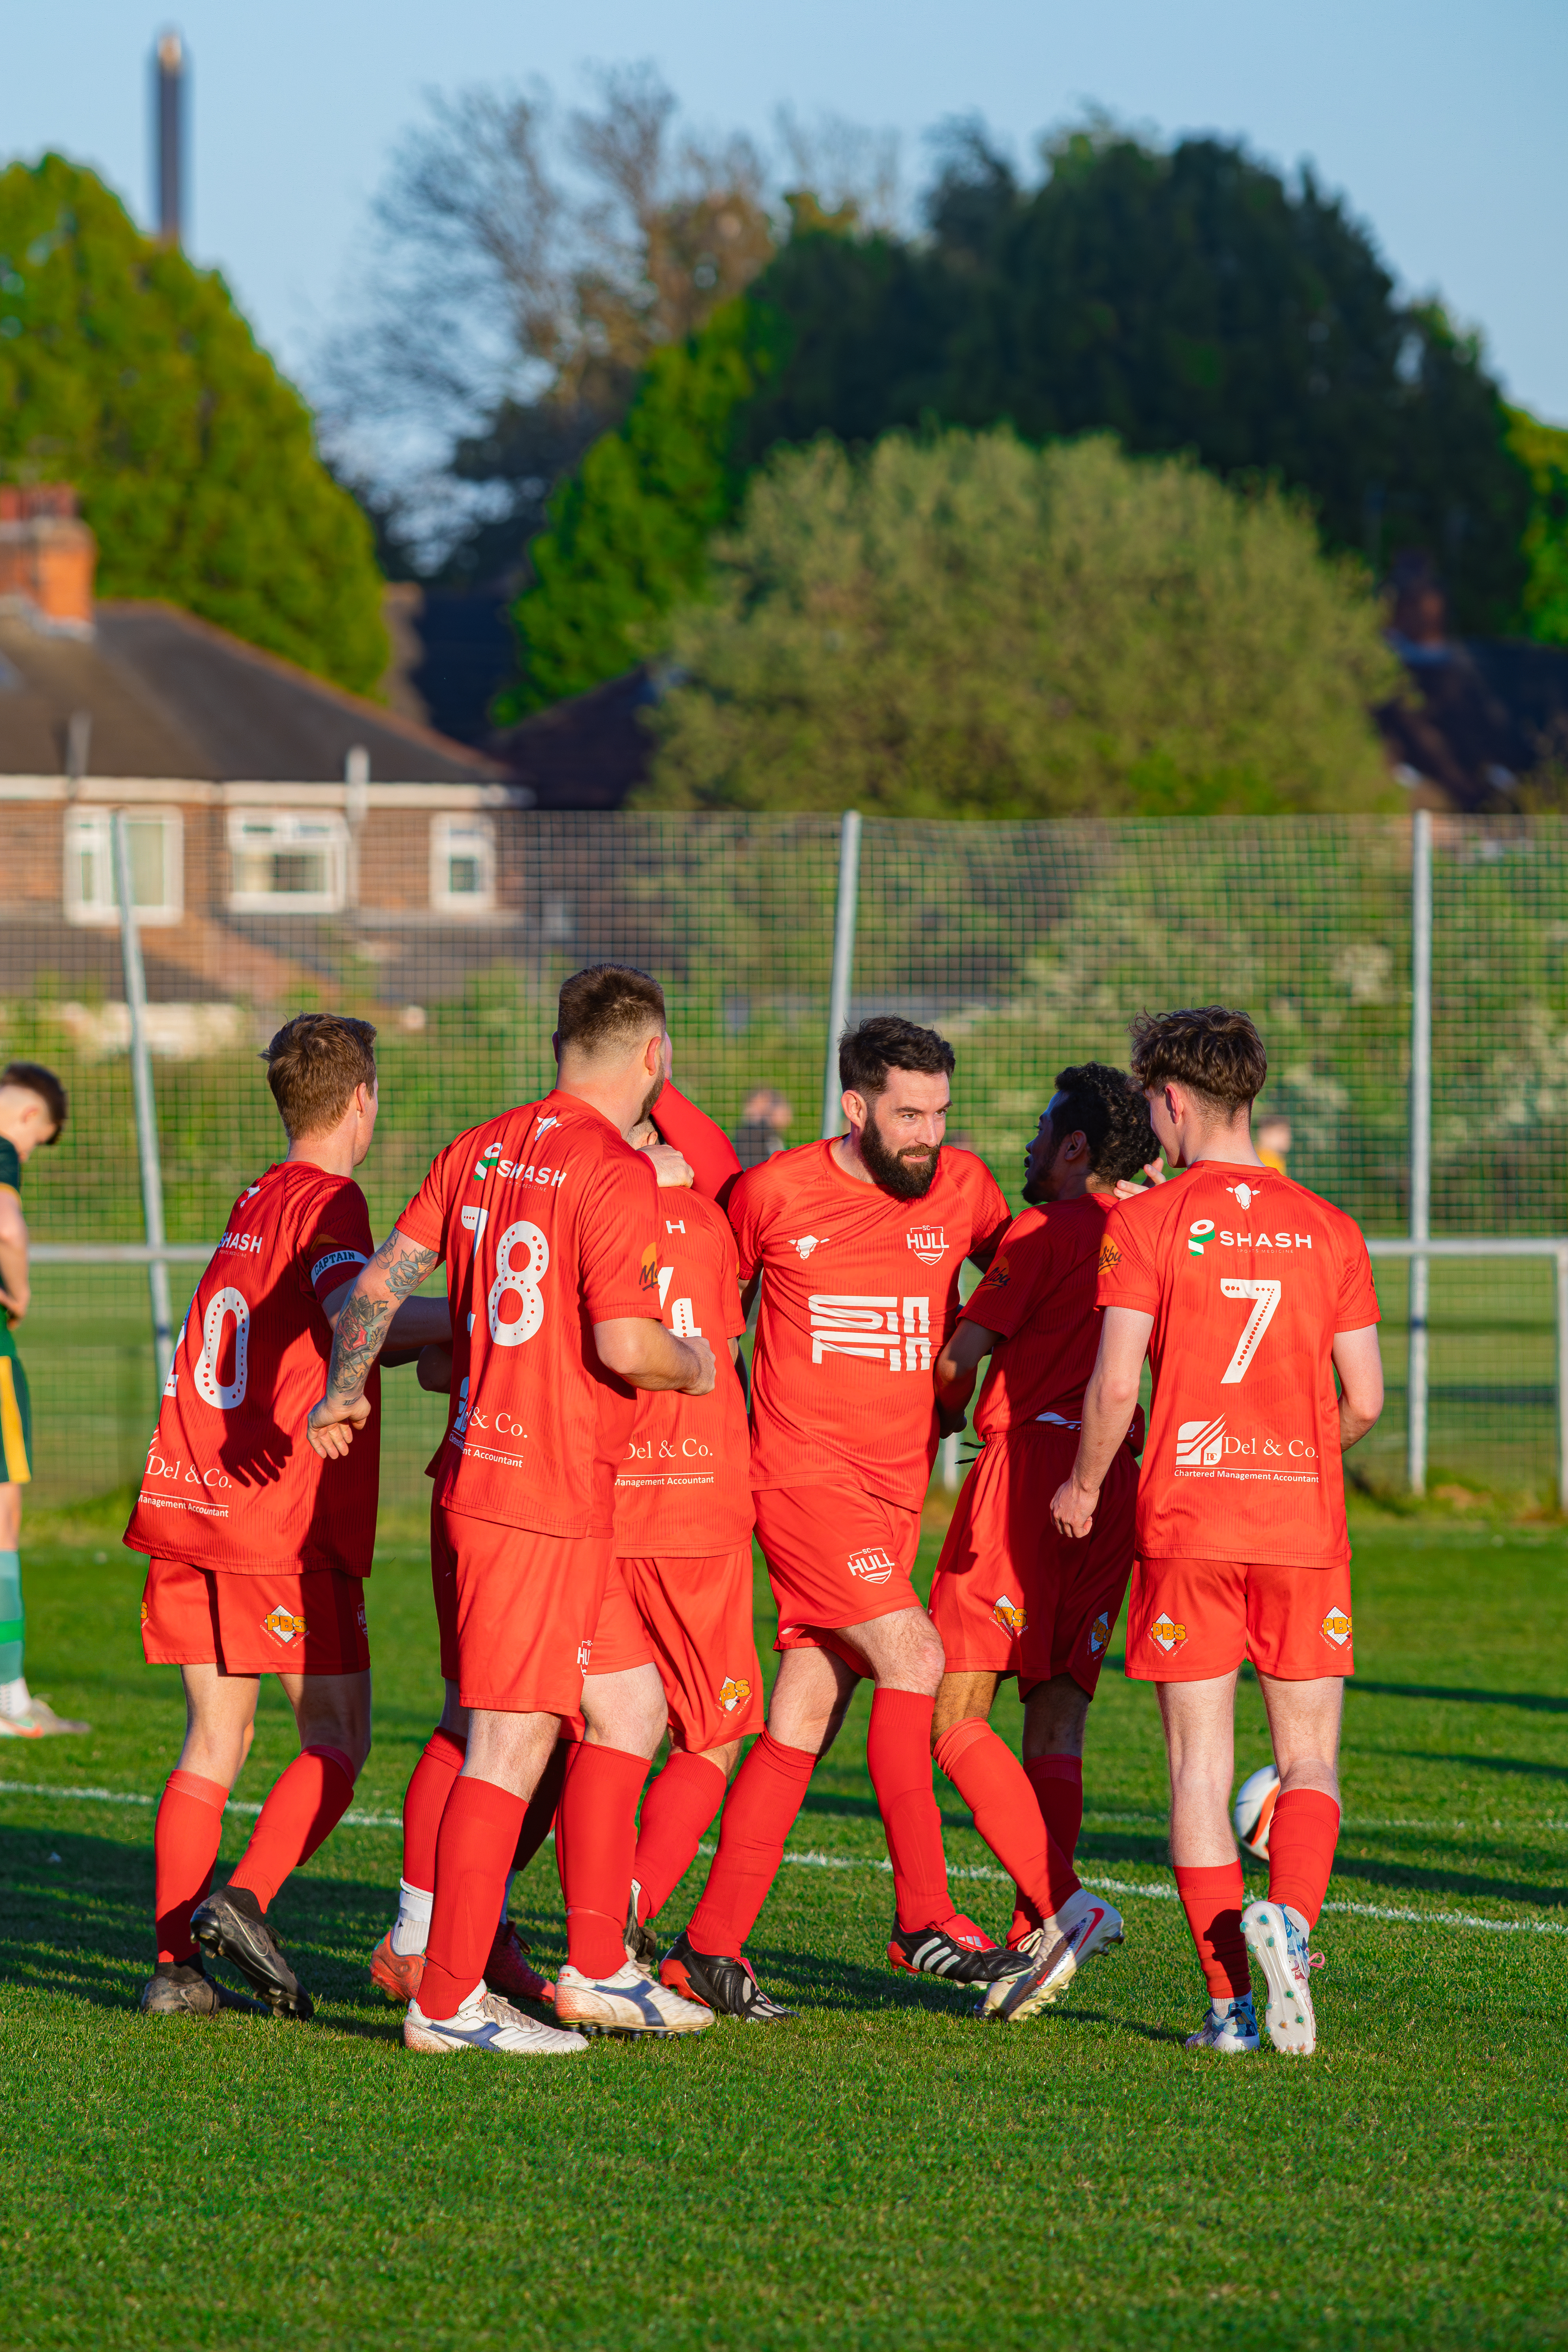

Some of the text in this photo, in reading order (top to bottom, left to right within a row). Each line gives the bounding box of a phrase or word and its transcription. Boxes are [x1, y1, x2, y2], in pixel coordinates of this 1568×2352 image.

[496, 1160, 567, 1188] SHASH
[218, 1232, 263, 1254] SHASH
[906, 1232, 949, 1249] HULL
[1220, 1230, 1312, 1249] SHASH
[314, 1252, 355, 1276] CAPTAIN
[1220, 1278, 1281, 1384] 7
[495, 1412, 528, 1438] Co.
[659, 1440, 677, 1458] &
[682, 1438, 713, 1457] Co.
[1223, 1437, 1319, 1458] Del & Co.
[473, 1449, 523, 1468] Accountant
[145, 1454, 232, 1488] Del & Co.
[667, 1475, 714, 1485] Accountant
[1174, 1469, 1319, 1483] Chartered Management Accountant
[188, 1503, 229, 1518] Accountant
[847, 1553, 895, 1576] HULL
[266, 1614, 308, 1633] PBS
[993, 1605, 1027, 1627] PBS
[989, 1617, 1012, 1641] CONSTRUCTION
[1152, 1622, 1186, 1641] PBS
